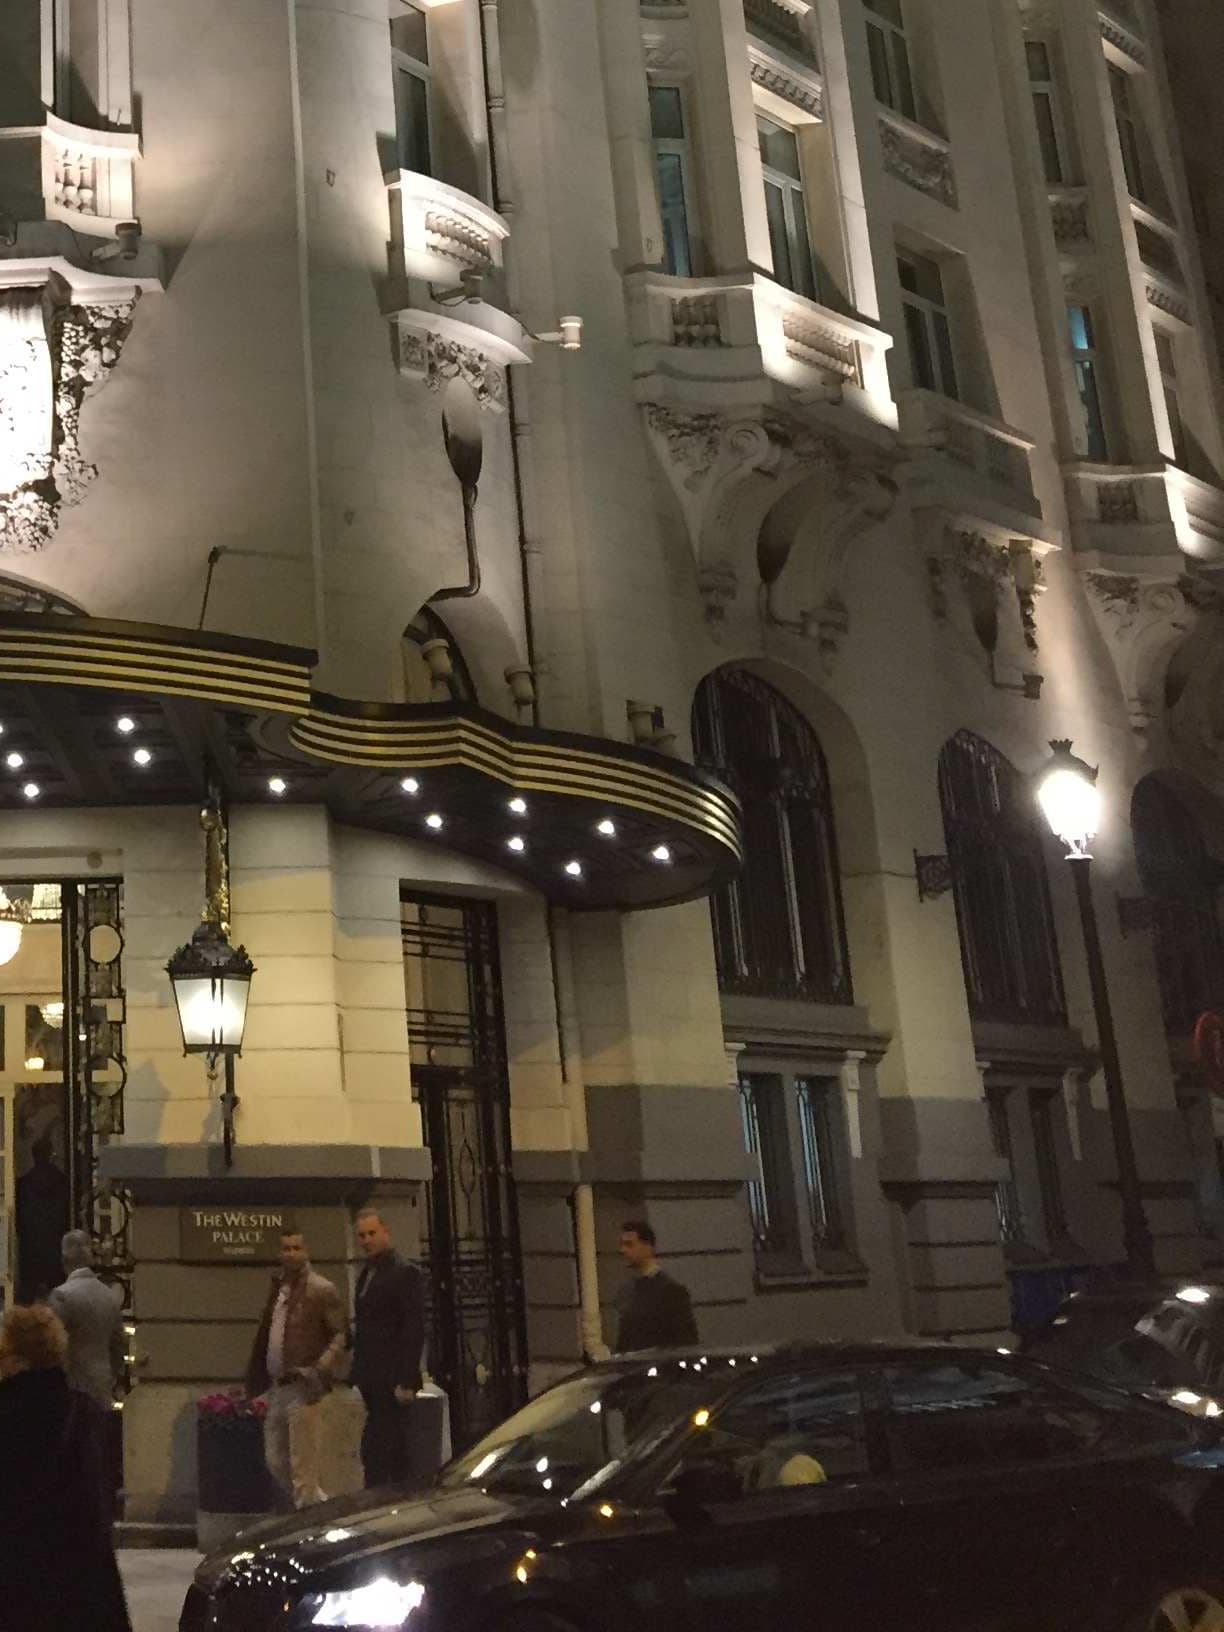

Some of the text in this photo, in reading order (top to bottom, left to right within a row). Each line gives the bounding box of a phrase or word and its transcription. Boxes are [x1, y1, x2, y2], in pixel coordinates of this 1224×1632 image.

[192, 1211, 282, 1228] THE WESTIN
[212, 1231, 265, 1243] PALACE
